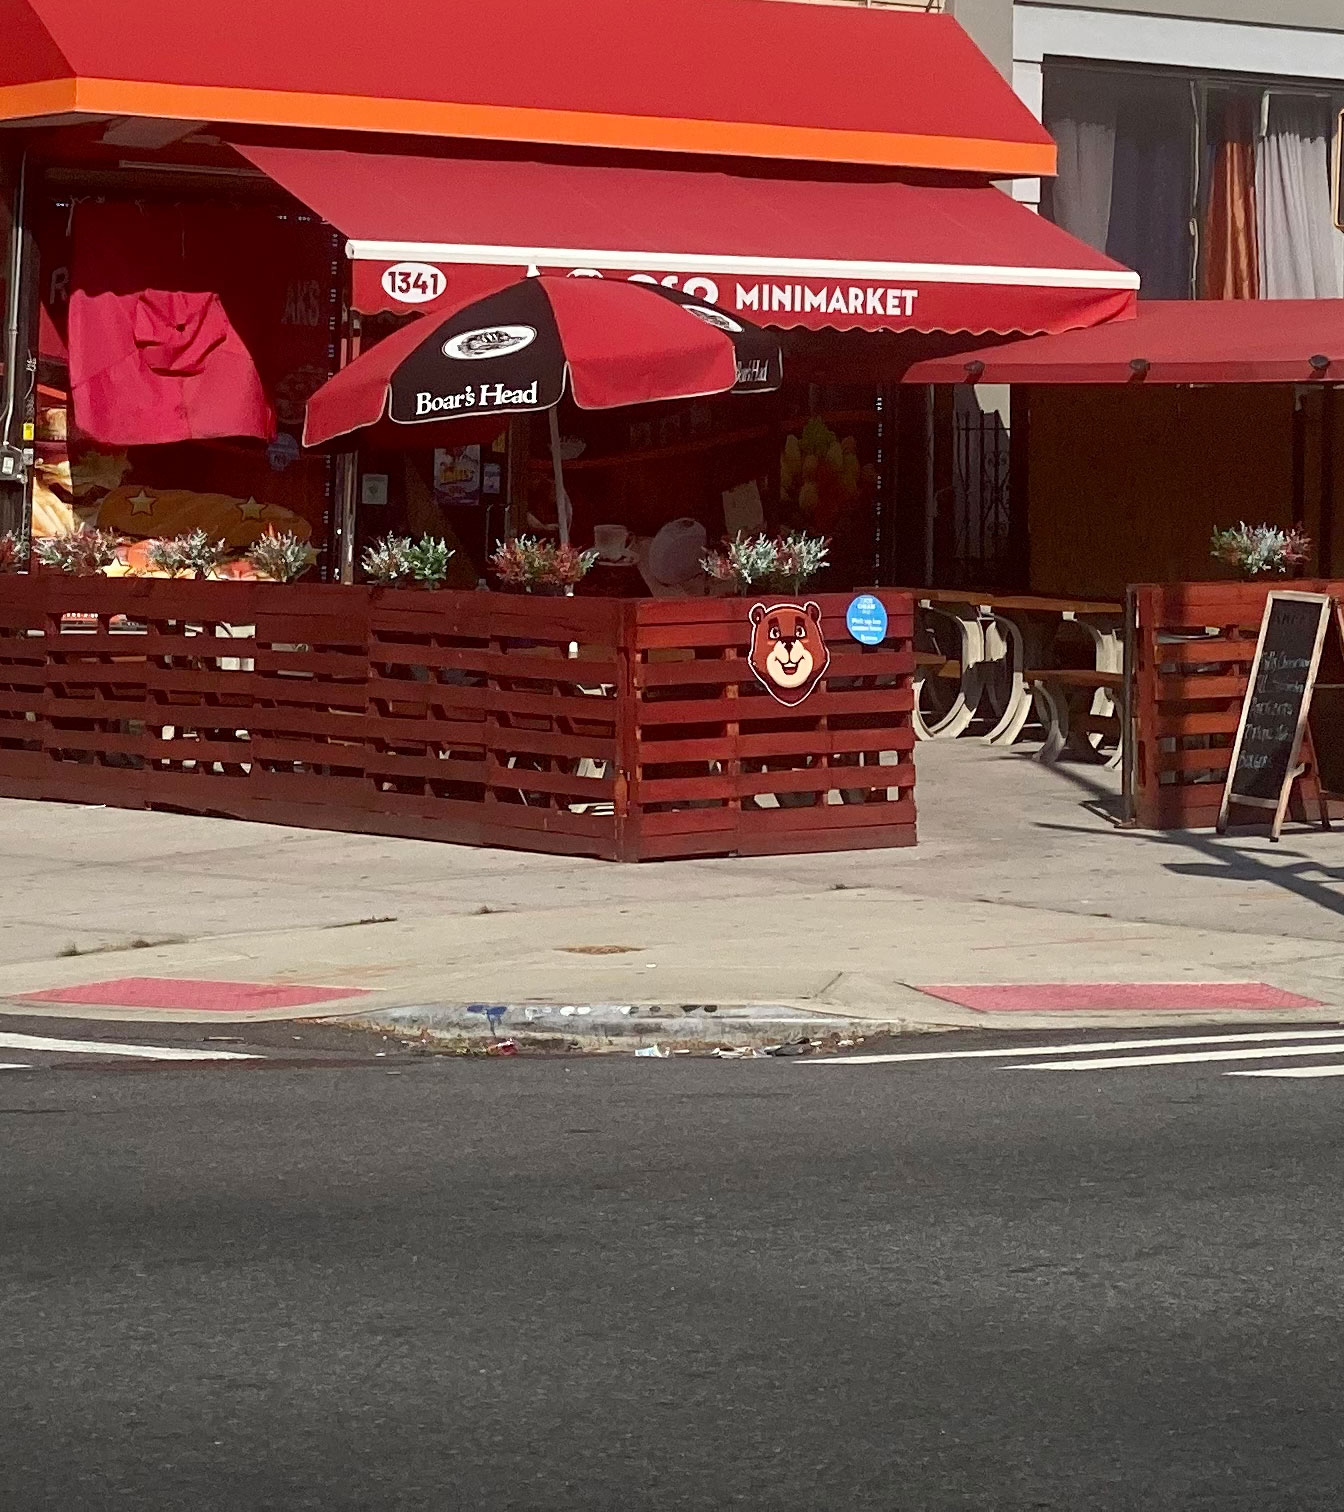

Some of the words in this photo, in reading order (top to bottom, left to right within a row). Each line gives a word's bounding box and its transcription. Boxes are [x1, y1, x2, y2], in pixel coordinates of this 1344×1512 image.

[387, 271, 439, 295] 1341
[735, 282, 919, 317] MINIMARKET
[416, 385, 476, 415] Boar's
[479, 380, 538, 406] Head
